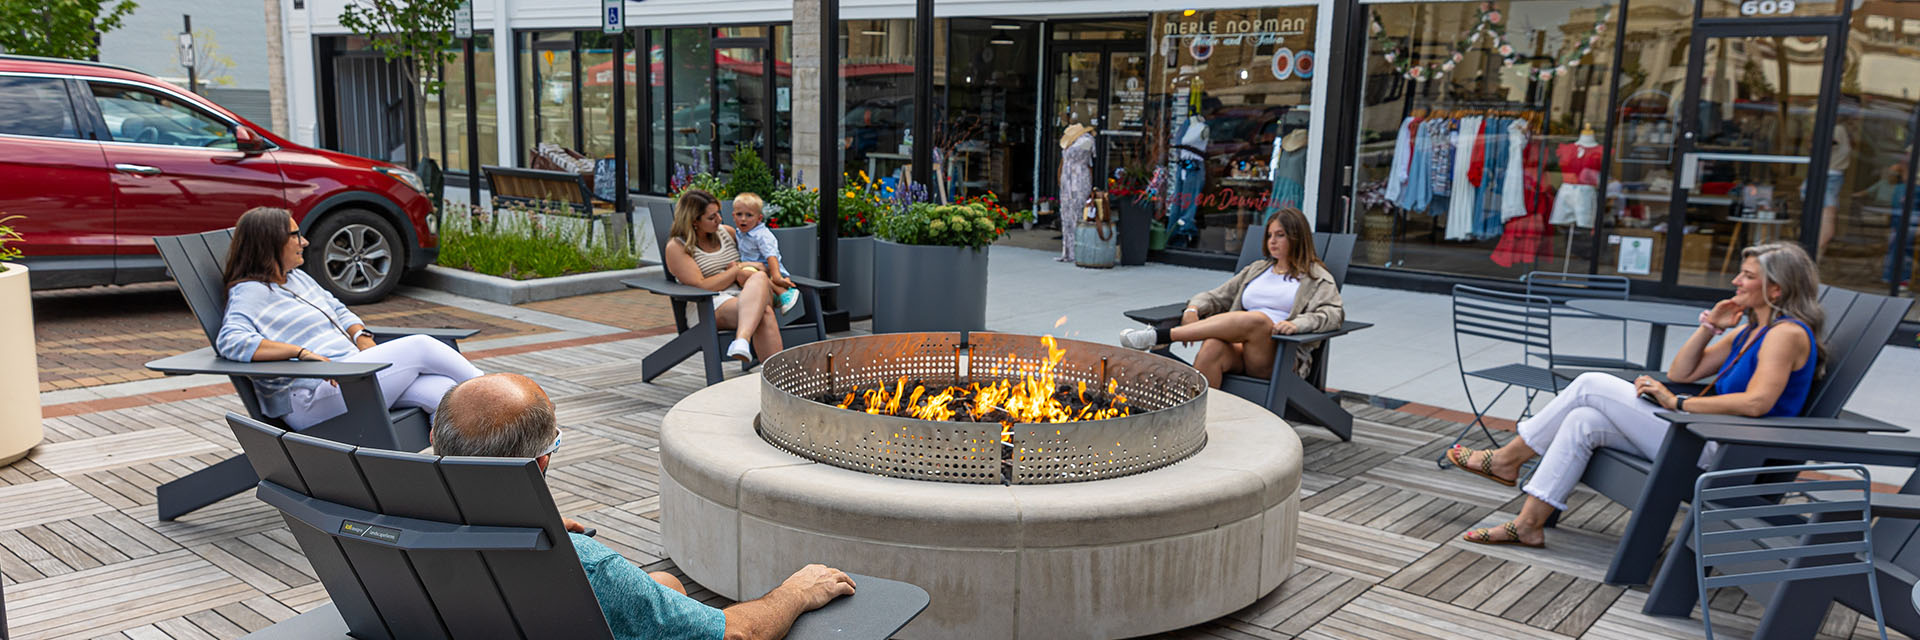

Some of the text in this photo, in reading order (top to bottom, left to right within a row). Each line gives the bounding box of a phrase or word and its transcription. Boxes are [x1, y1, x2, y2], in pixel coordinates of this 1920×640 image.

[1740, 0, 1796, 15] 609
[1164, 18, 1305, 35] MERLE NORMAN
